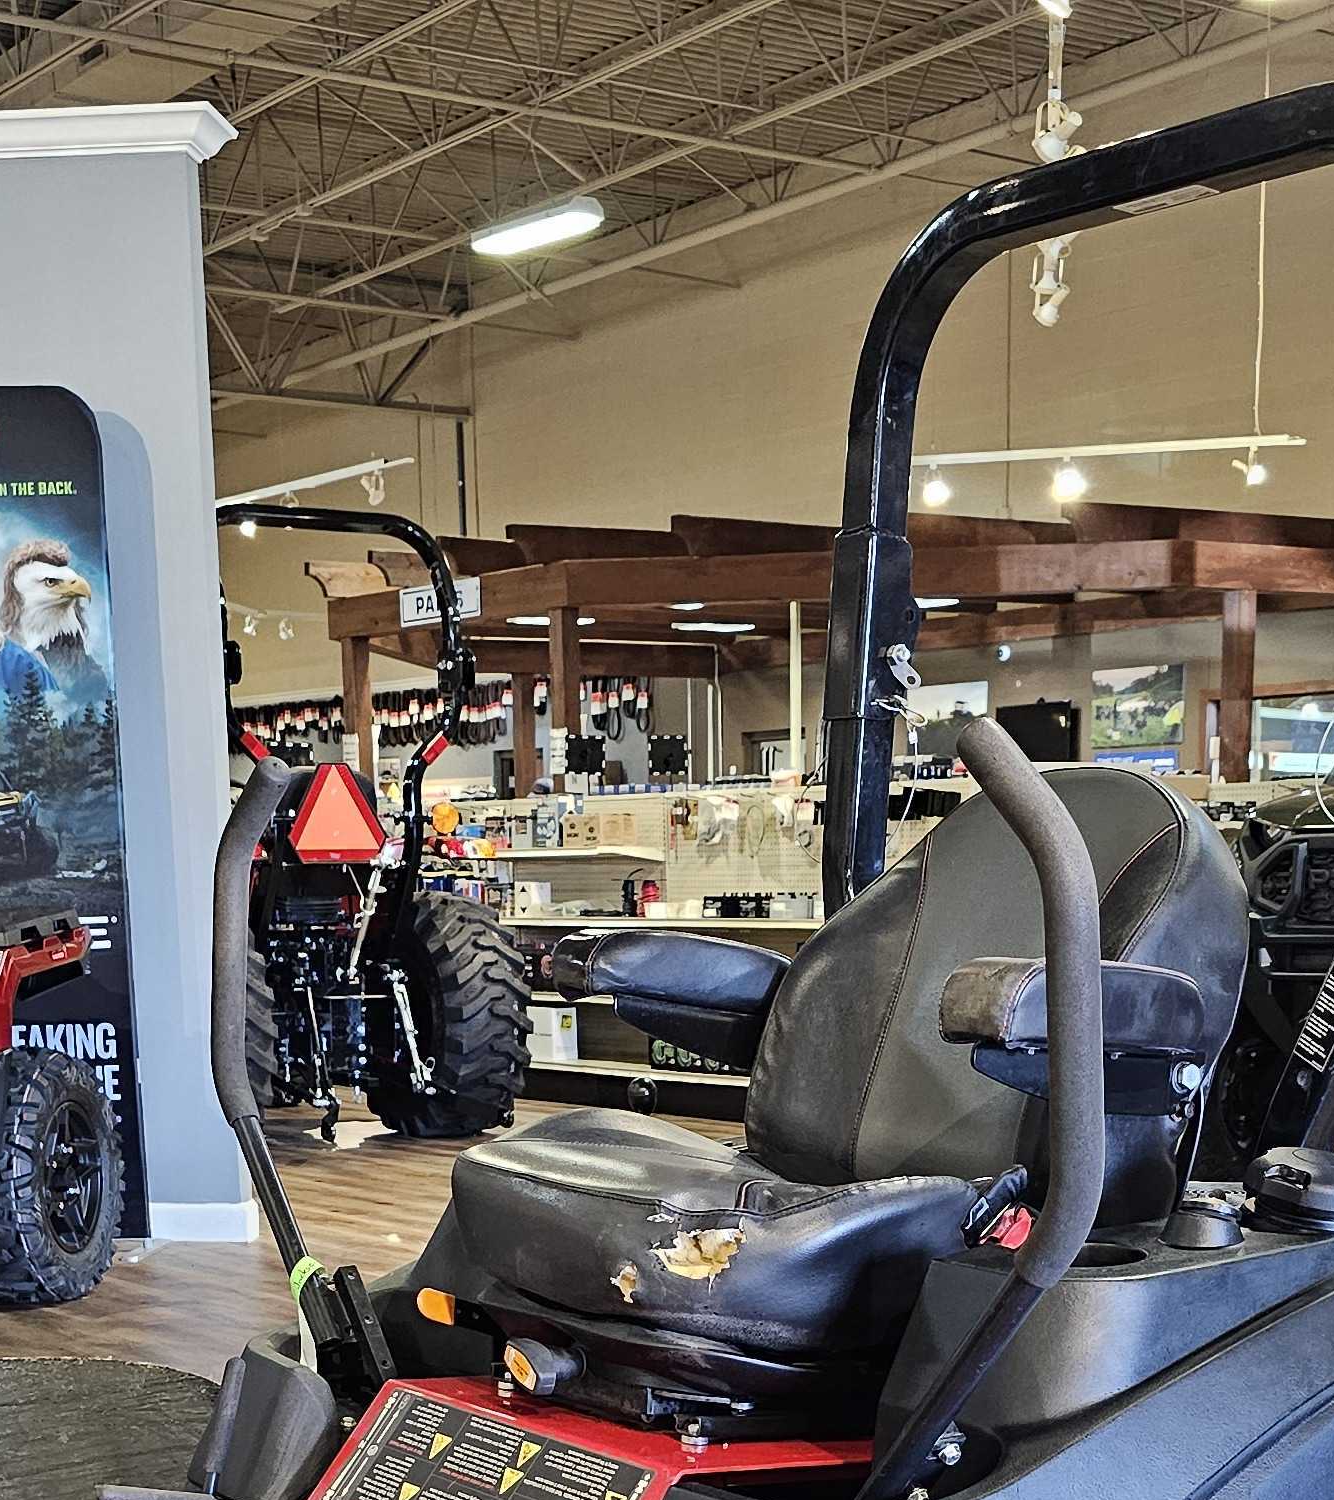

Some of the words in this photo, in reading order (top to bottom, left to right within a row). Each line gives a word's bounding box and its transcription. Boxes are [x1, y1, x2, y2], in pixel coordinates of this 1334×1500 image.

[10, 482, 35, 496] THE
[38, 481, 77, 495] BACK.
[416, 590, 464, 614] PAS
